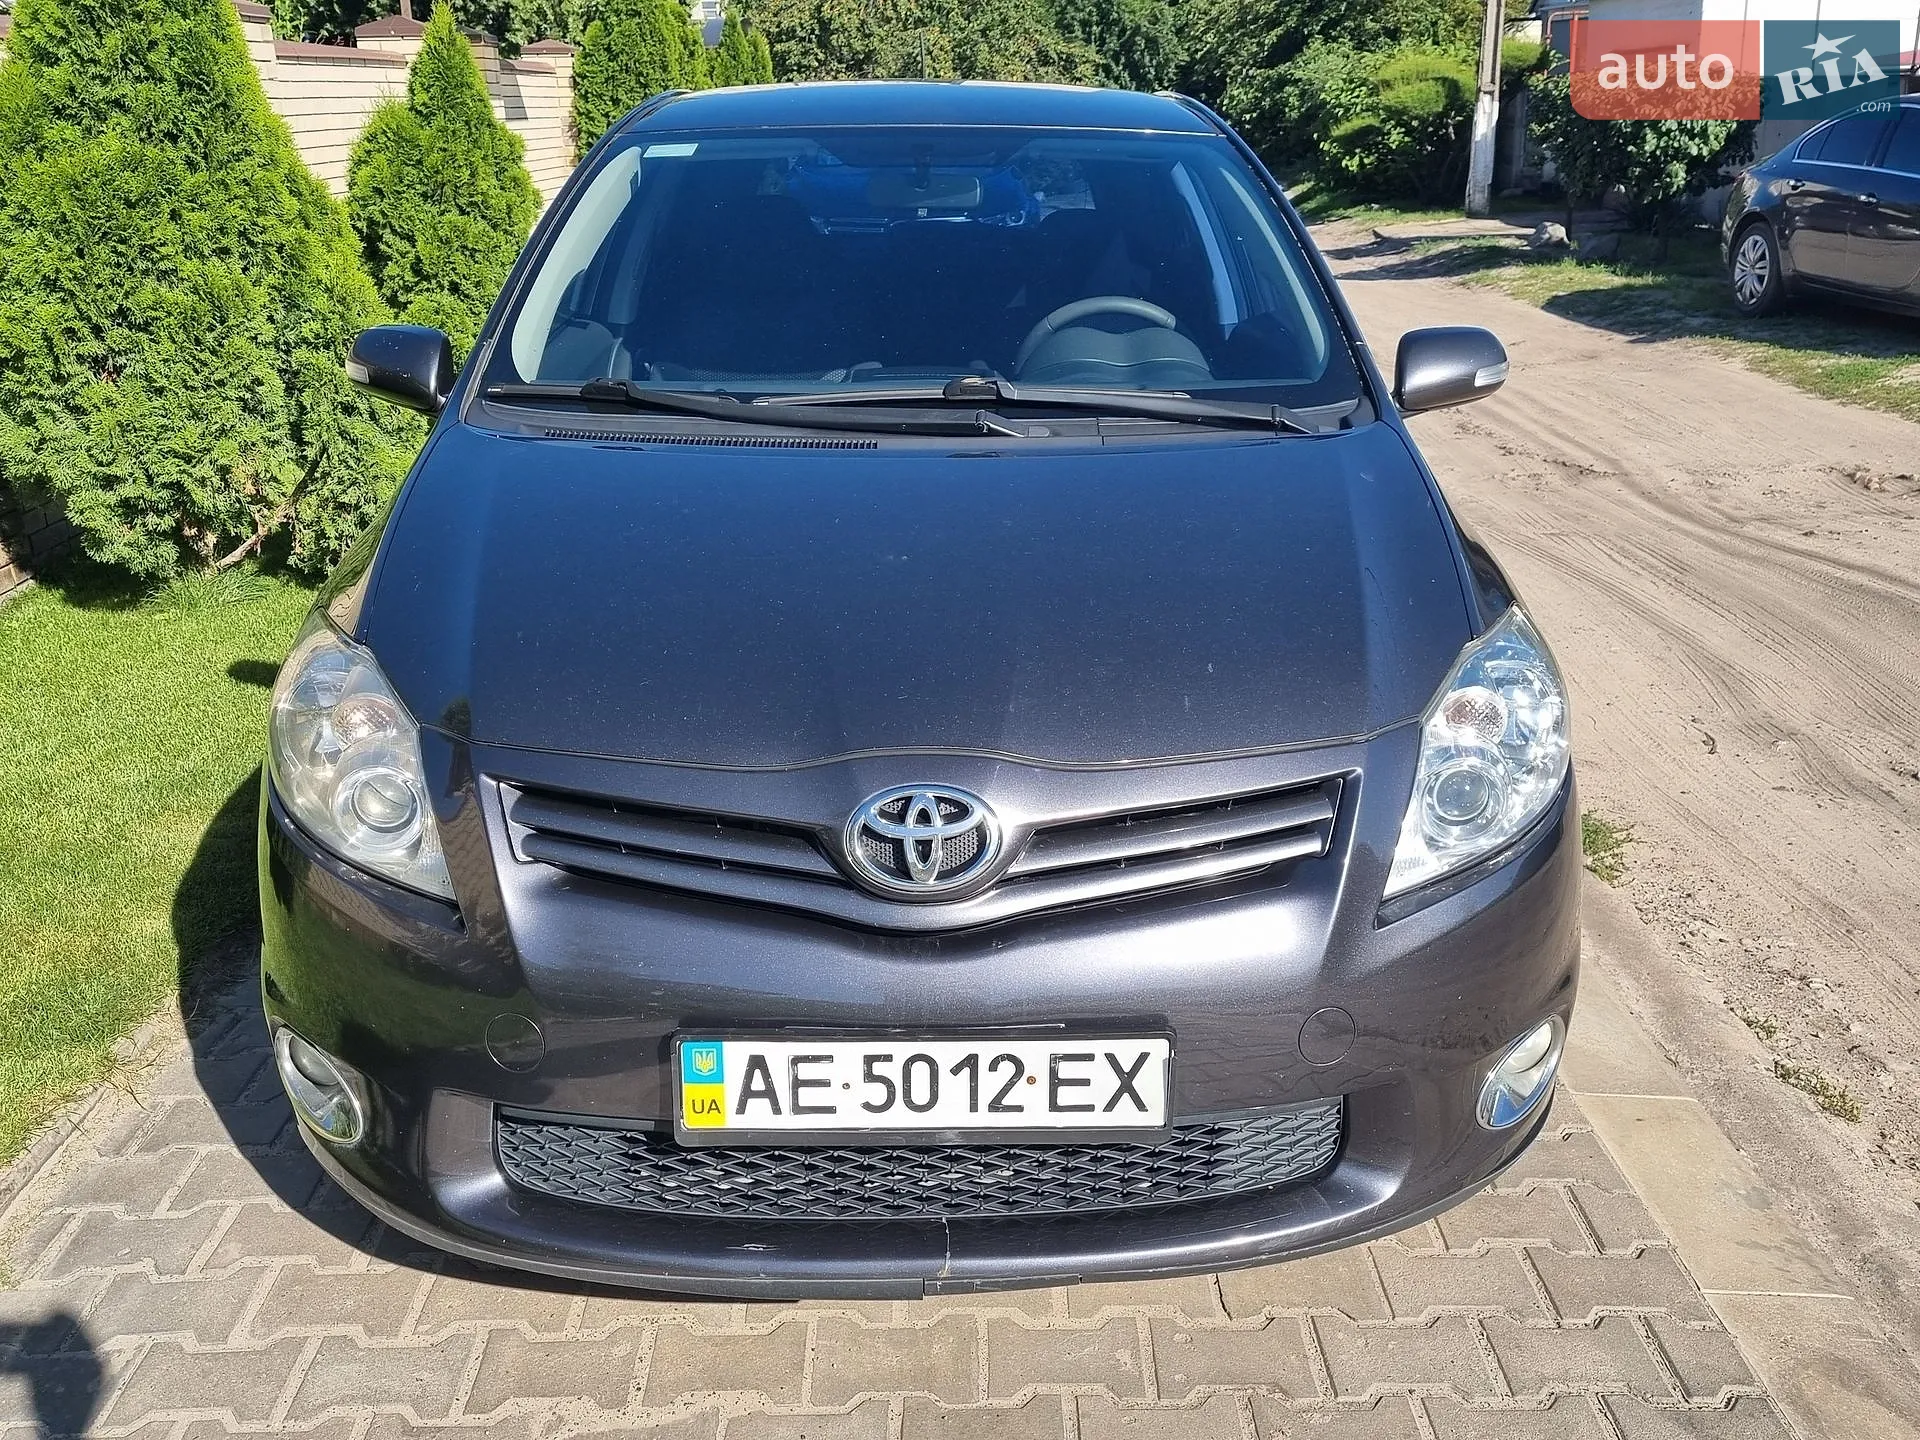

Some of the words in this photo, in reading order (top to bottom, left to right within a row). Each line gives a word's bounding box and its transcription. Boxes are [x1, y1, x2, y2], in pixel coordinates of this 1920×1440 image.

[735, 1054, 837, 1115] AE
[860, 1053, 1025, 1113] 5012
[1049, 1052, 1151, 1113] EX
[691, 1098, 722, 1115] UA
